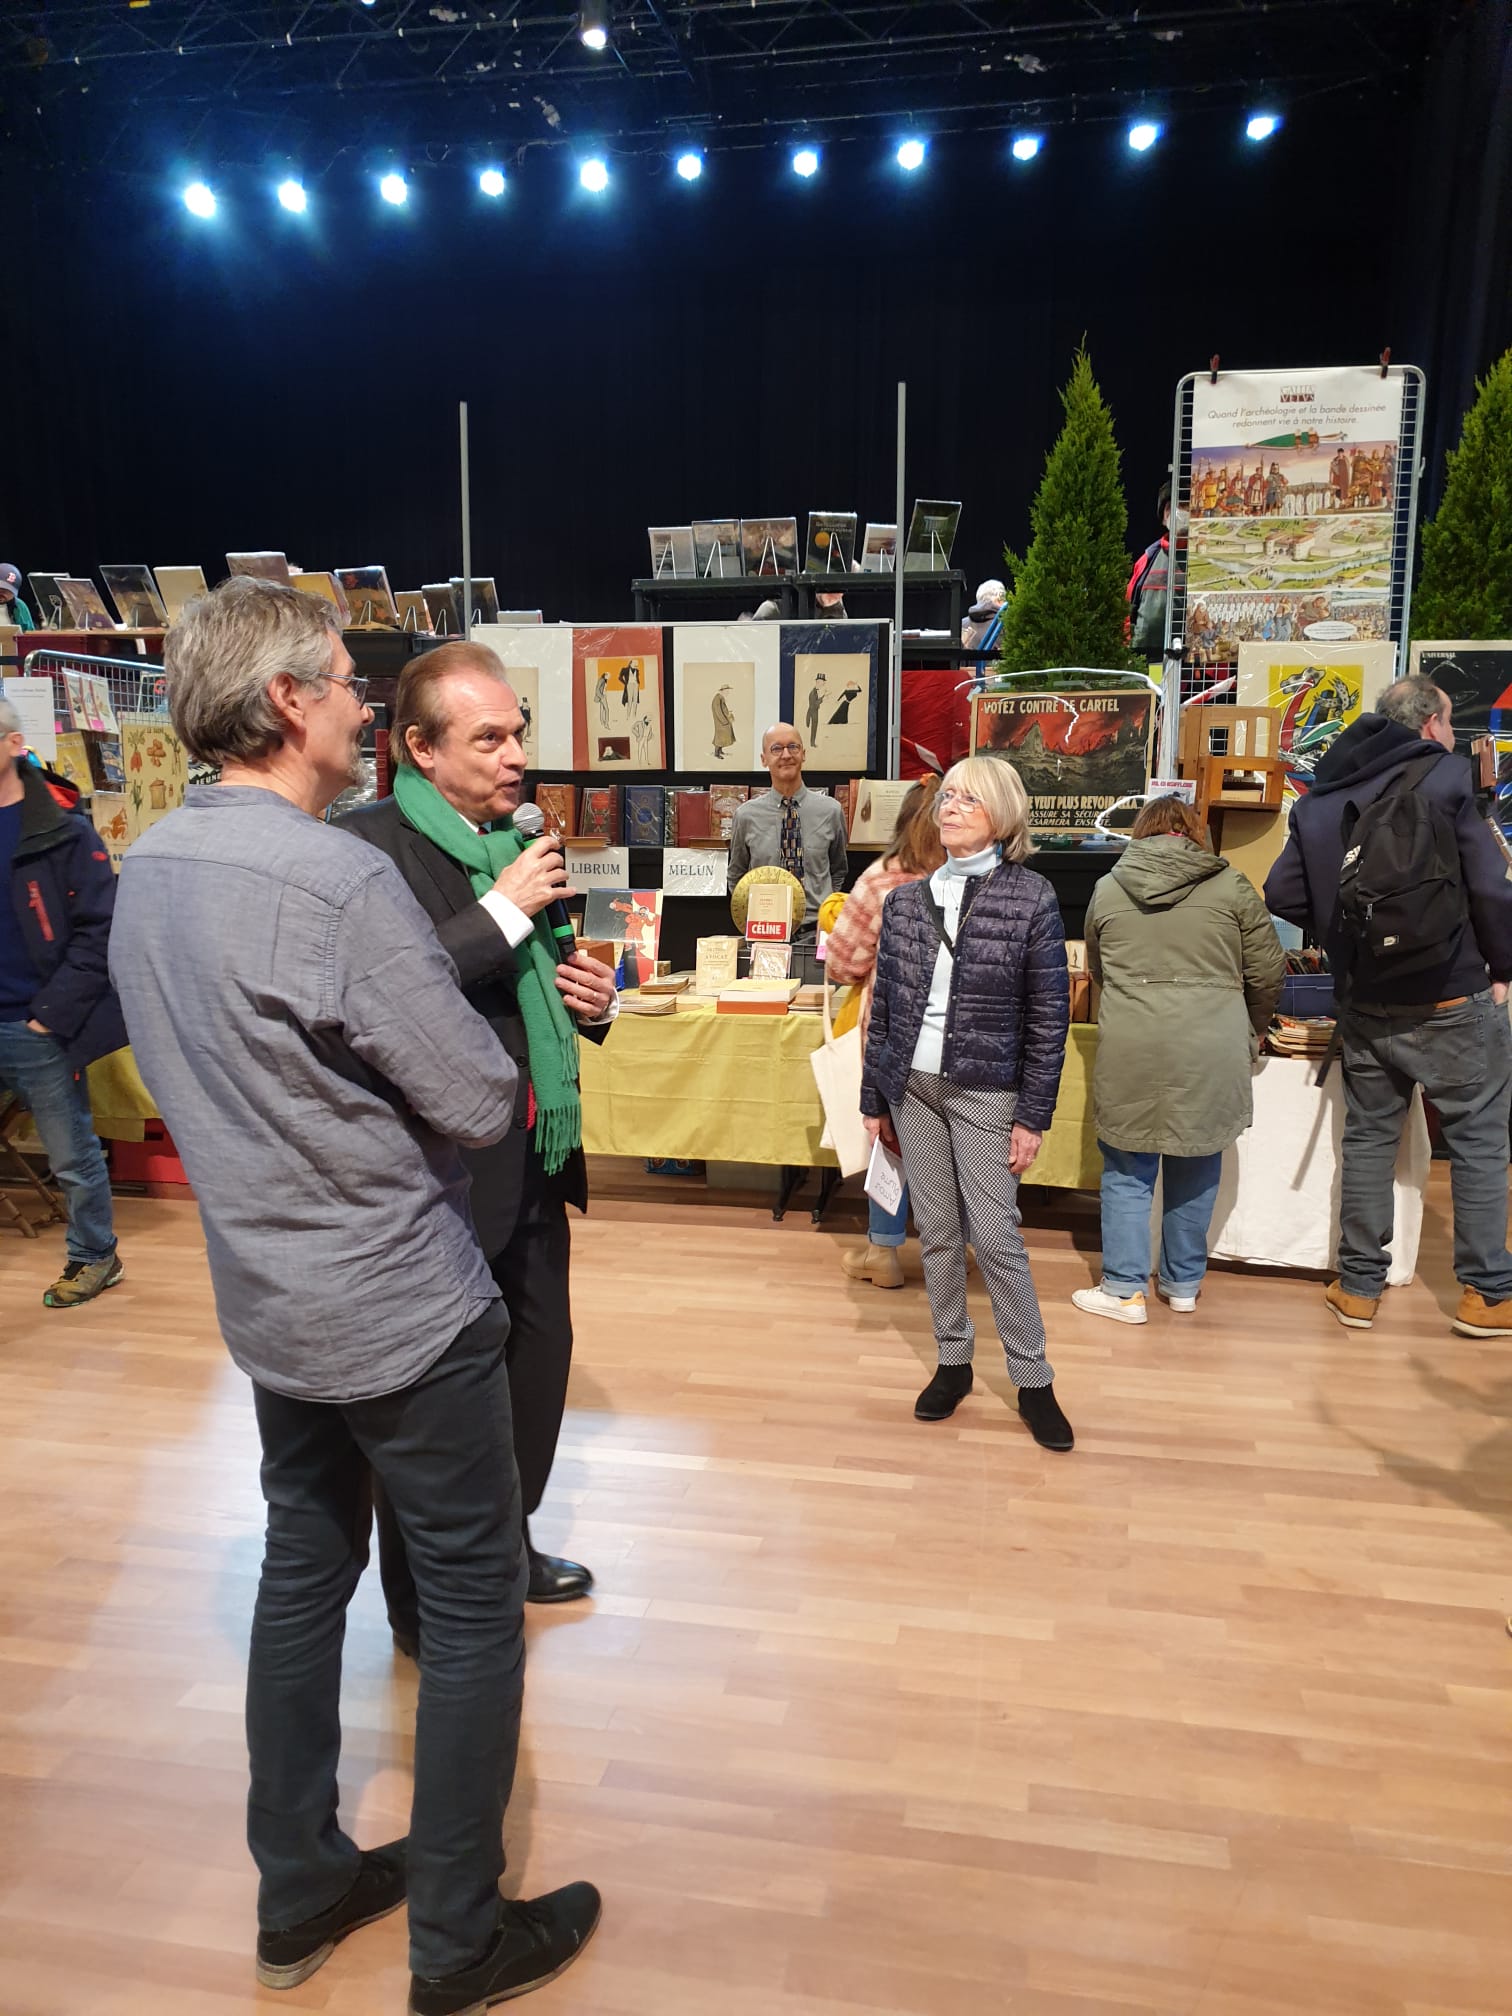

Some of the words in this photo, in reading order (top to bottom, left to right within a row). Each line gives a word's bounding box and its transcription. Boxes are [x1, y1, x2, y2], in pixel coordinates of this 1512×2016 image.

[1207, 408, 1239, 419] Quand
[1241, 405, 1297, 417] l'archéologie
[1299, 406, 1307, 414] et
[1309, 405, 1318, 414] la
[1320, 404, 1347, 414] bande
[1349, 403, 1386, 413] dessinée
[1232, 418, 1276, 428] redonnent
[1301, 417, 1323, 425] notre
[984, 701, 1015, 714] VOTEZ
[1020, 700, 1059, 714] CONTRE
[1063, 699, 1076, 713] LE
[1080, 698, 1120, 712] CARTEL
[1034, 795, 1057, 810] VEUT
[1057, 795, 1079, 810] PLUS
[1081, 795, 1116, 810] REVOIR
[1060, 809, 1071, 818] SA
[571, 863, 620, 875] LIBRUM
[669, 864, 714, 876] MELUN
[751, 921, 782, 935] CÉLINE
